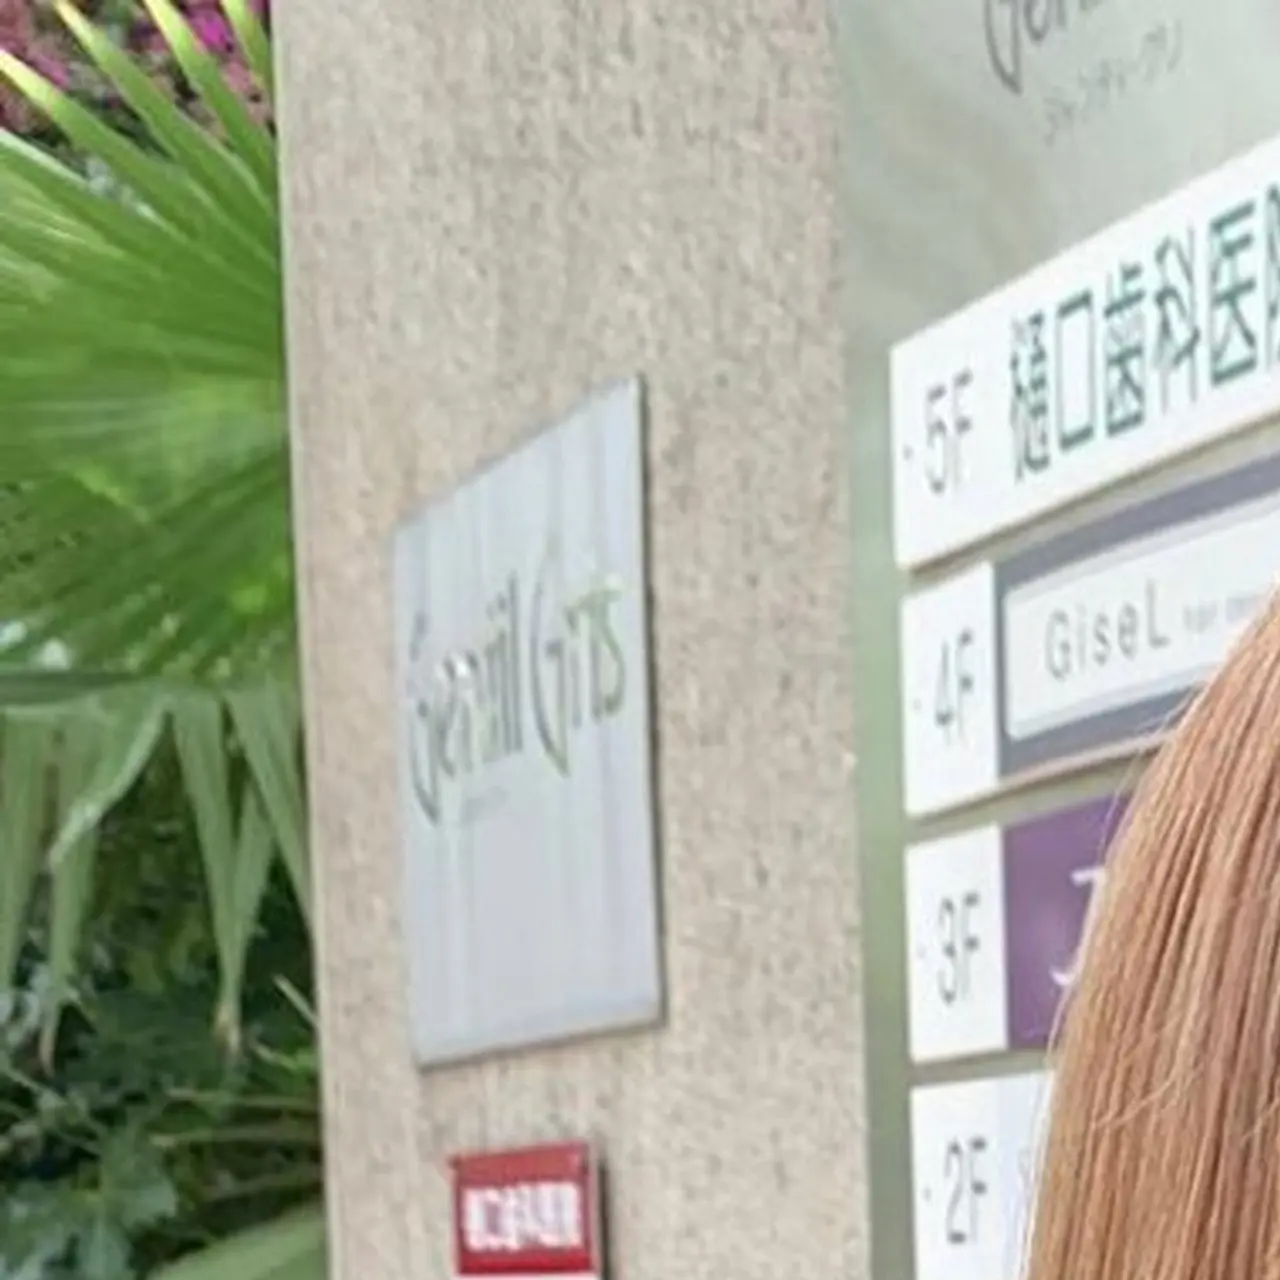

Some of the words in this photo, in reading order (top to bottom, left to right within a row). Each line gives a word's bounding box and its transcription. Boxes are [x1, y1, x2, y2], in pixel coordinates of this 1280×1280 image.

[922, 369, 973, 495] 5F
[934, 631, 975, 747] 4F
[936, 891, 980, 1006] 3F
[944, 1136, 988, 1246] 2F
